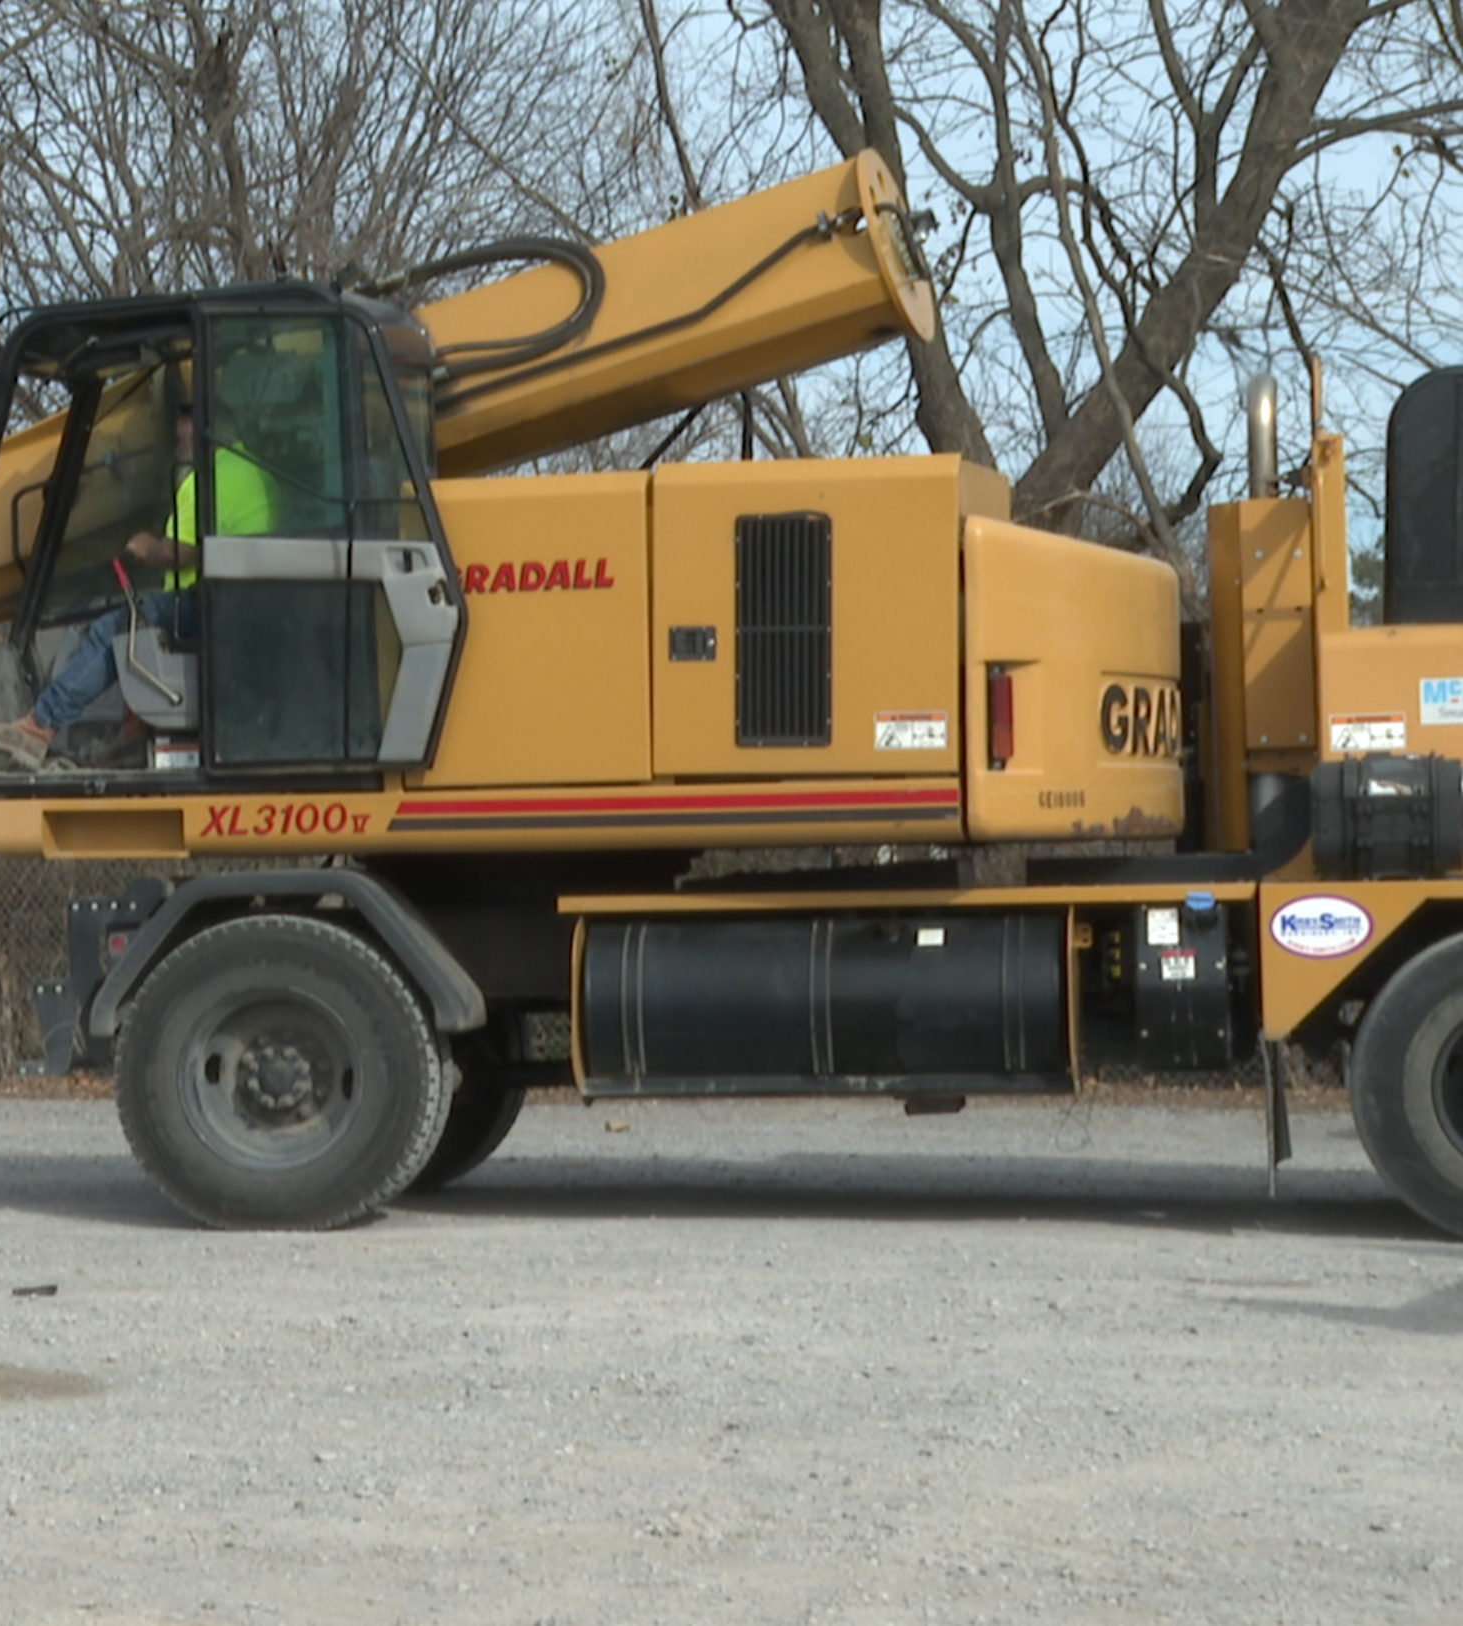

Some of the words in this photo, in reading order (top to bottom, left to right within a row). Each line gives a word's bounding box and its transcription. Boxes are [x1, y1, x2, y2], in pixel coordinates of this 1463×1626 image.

[457, 558, 614, 594] RADALL
[1422, 679, 1463, 704] Mc
[200, 803, 348, 837] XL3100
